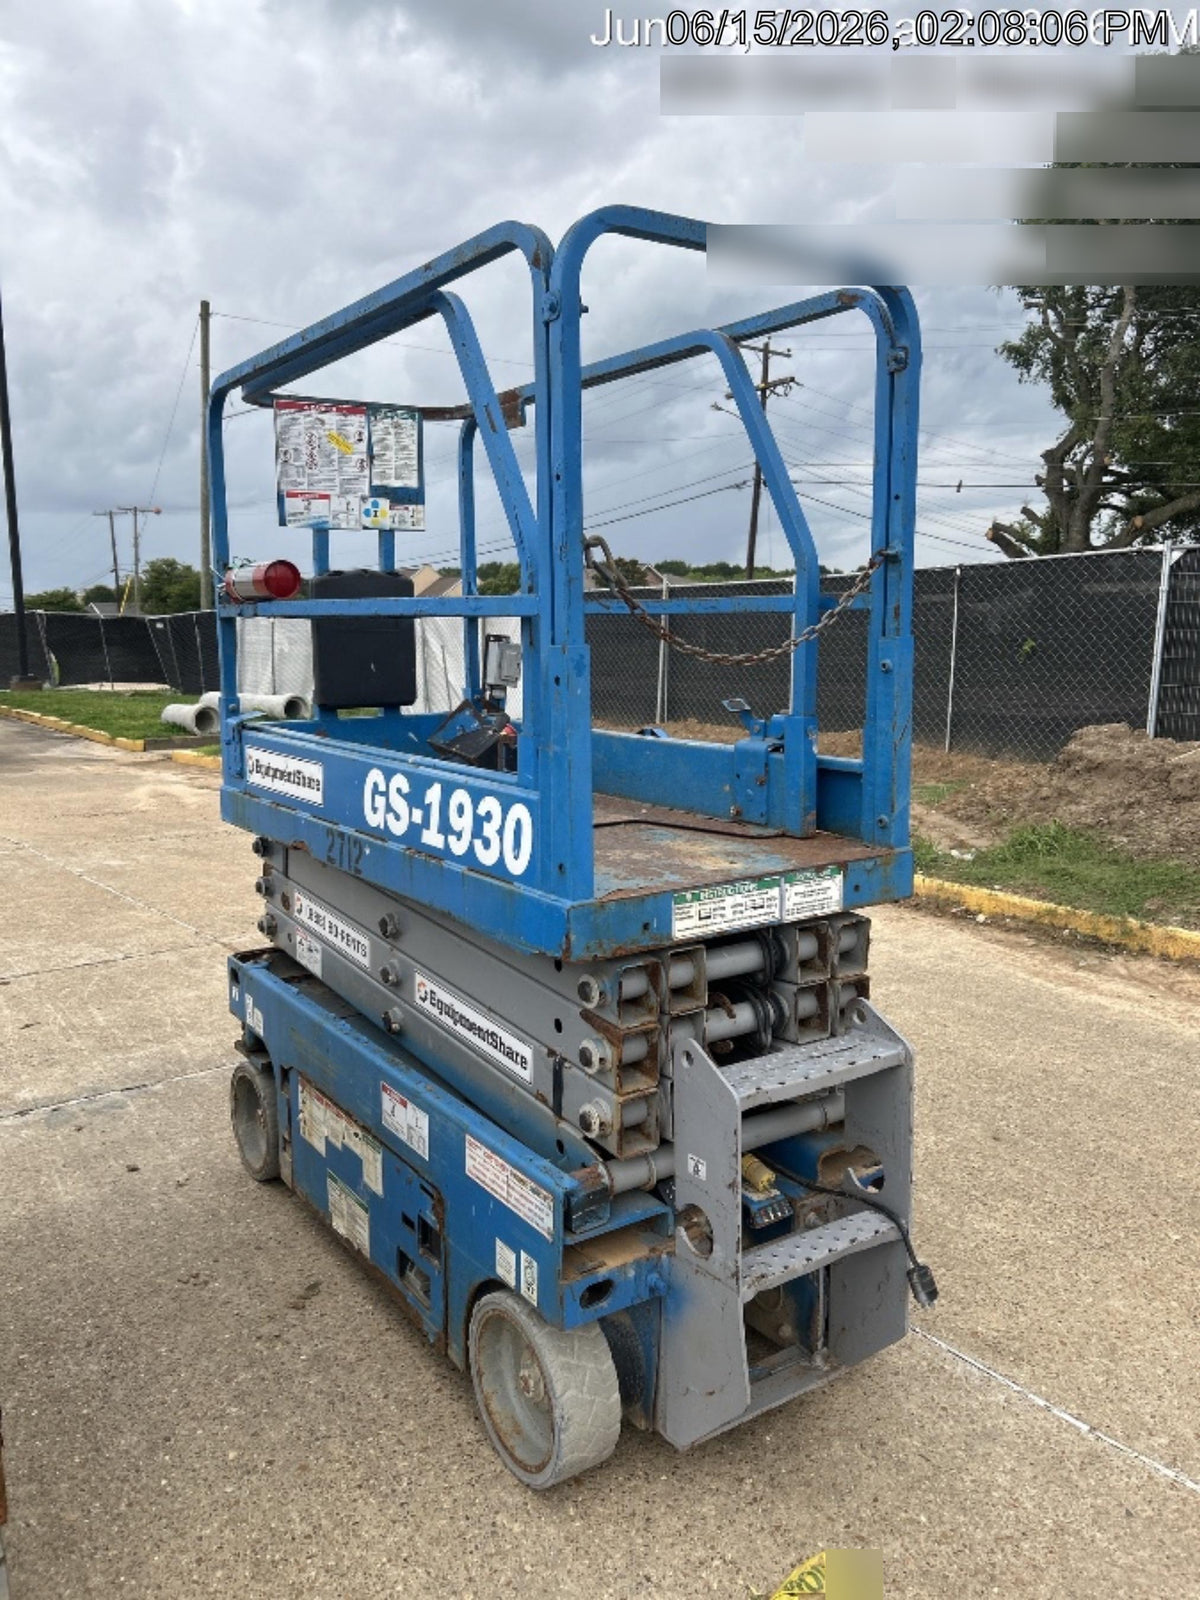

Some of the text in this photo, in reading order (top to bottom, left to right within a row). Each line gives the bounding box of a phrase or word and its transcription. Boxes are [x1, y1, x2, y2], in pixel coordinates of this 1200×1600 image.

[326, 828, 364, 875] 2712
[363, 767, 533, 876] GS-1930
[429, 988, 529, 1071] EquipmentShare
